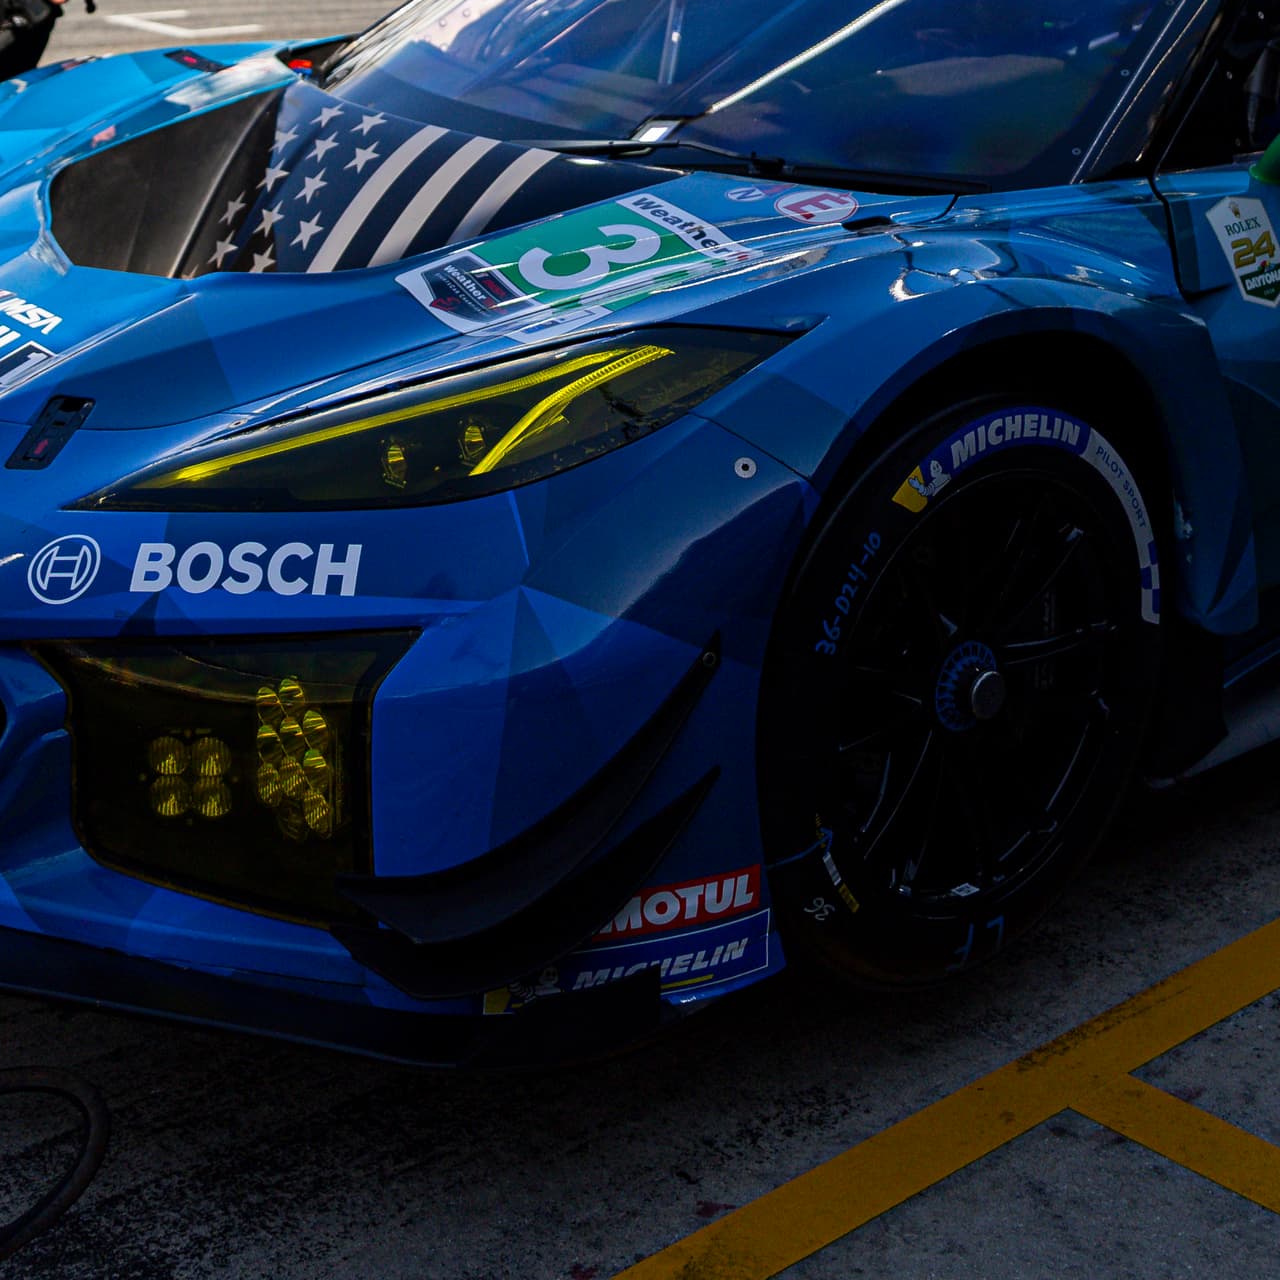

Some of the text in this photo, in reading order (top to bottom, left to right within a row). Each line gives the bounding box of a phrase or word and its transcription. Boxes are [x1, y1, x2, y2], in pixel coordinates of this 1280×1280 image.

[631, 197, 750, 260] Weather
[1224, 216, 1261, 236] ROLEX
[1231, 231, 1276, 269] 24
[518, 223, 661, 290] 3
[951, 414, 1081, 469] MICHELIN
[1095, 446, 1146, 528] PILOT SPORT
[130, 542, 362, 597] BOSCH
[599, 873, 754, 934] MOTUL
